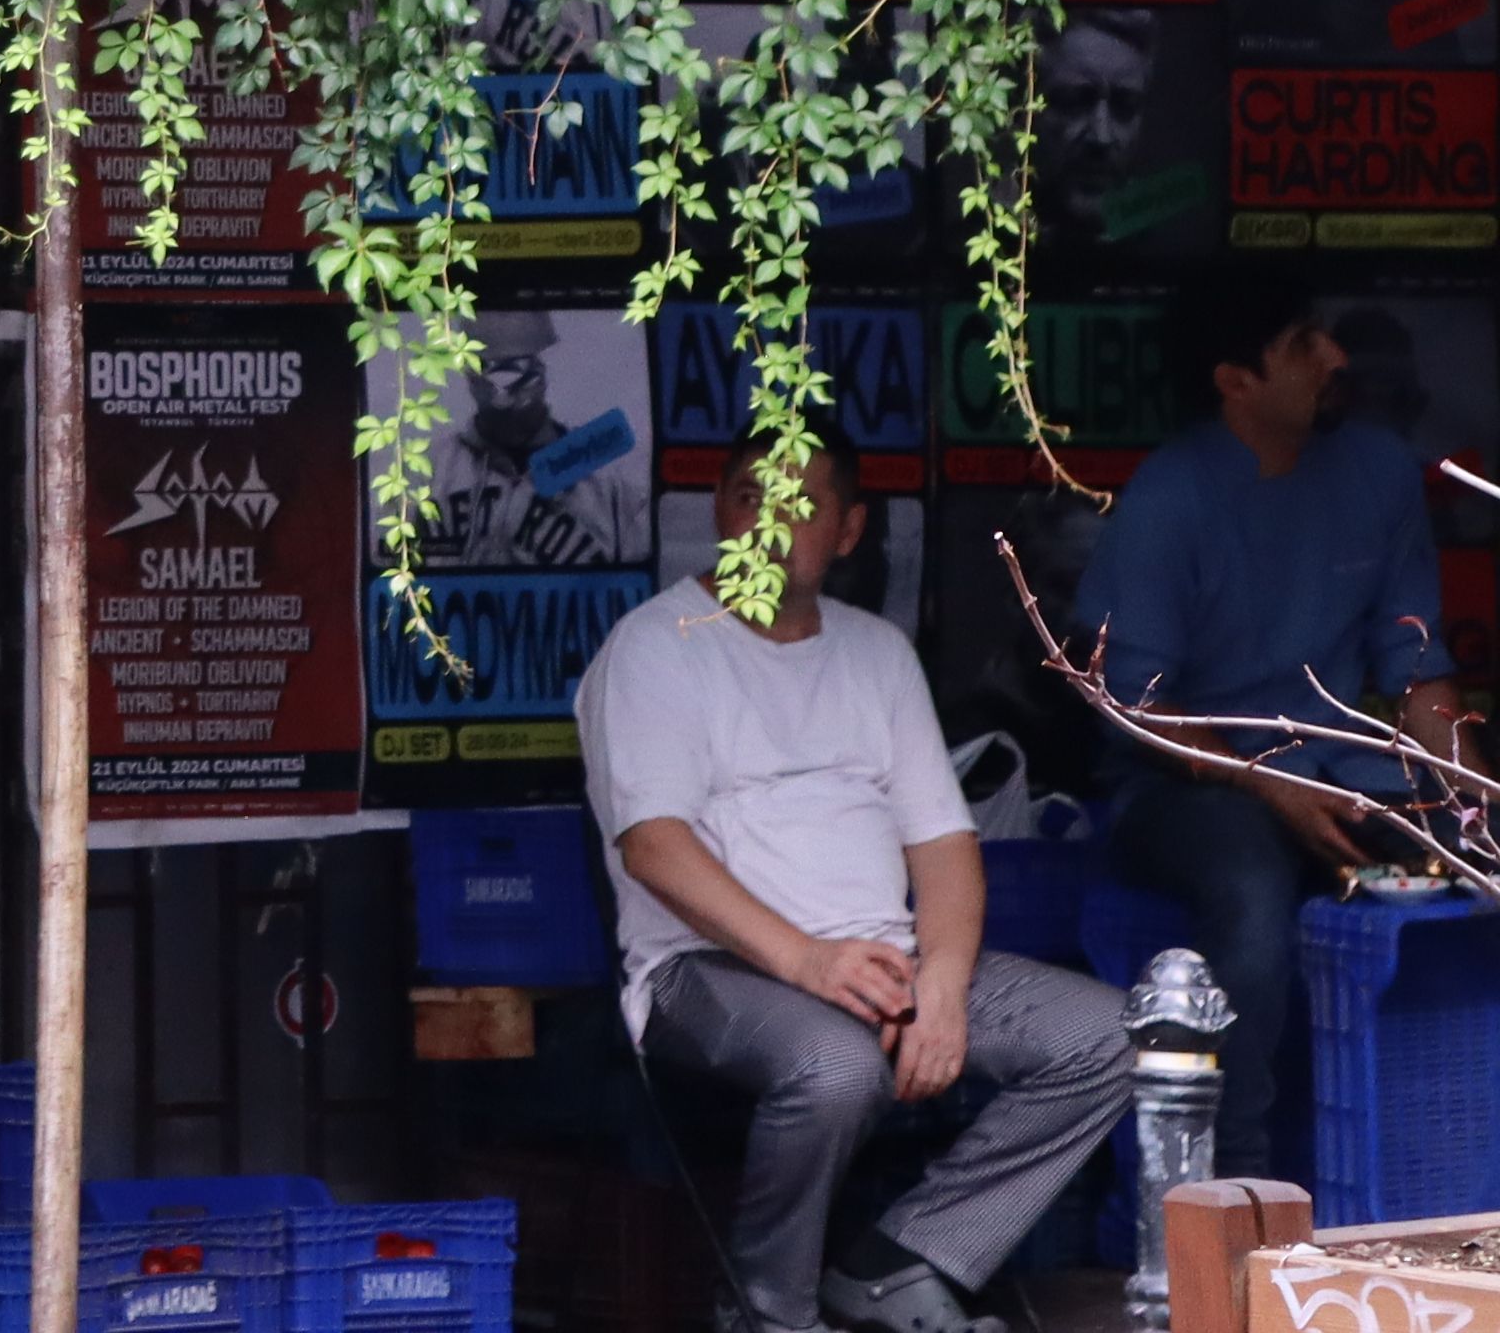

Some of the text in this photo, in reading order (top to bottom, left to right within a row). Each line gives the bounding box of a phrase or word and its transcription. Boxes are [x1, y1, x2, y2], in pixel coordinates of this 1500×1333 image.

[82, 92, 141, 117] LEGIO
[212, 94, 286, 118] DAMNED
[1240, 79, 1438, 135] CURTIS
[193, 158, 272, 182] OBLIVION
[1240, 141, 1490, 196] HARDING
[100, 252, 150, 269] EYLÜL
[160, 257, 195, 270] 024
[199, 253, 294, 270] CUMARTESİ
[174, 274, 206, 286] PARK
[216, 274, 244, 286] ANA
[90, 350, 302, 399] BOSPHORUS
[103, 399, 291, 414] OPEN AIR METAL FEST
[140, 546, 262, 590] SAMAEL
[99, 595, 302, 622] LEGION OF THE DAMNED
[91, 627, 310, 653] ANCIENT SCHAMMASCH
[111, 660, 287, 686] MORIBUND OBLIVION
[117, 692, 174, 714] HYPNOS
[381, 733, 443, 757] DJ SET
[92, 754, 306, 776] 21 EYLÜL 2024 CUMARTESİ
[188, 779, 220, 789] PARK
